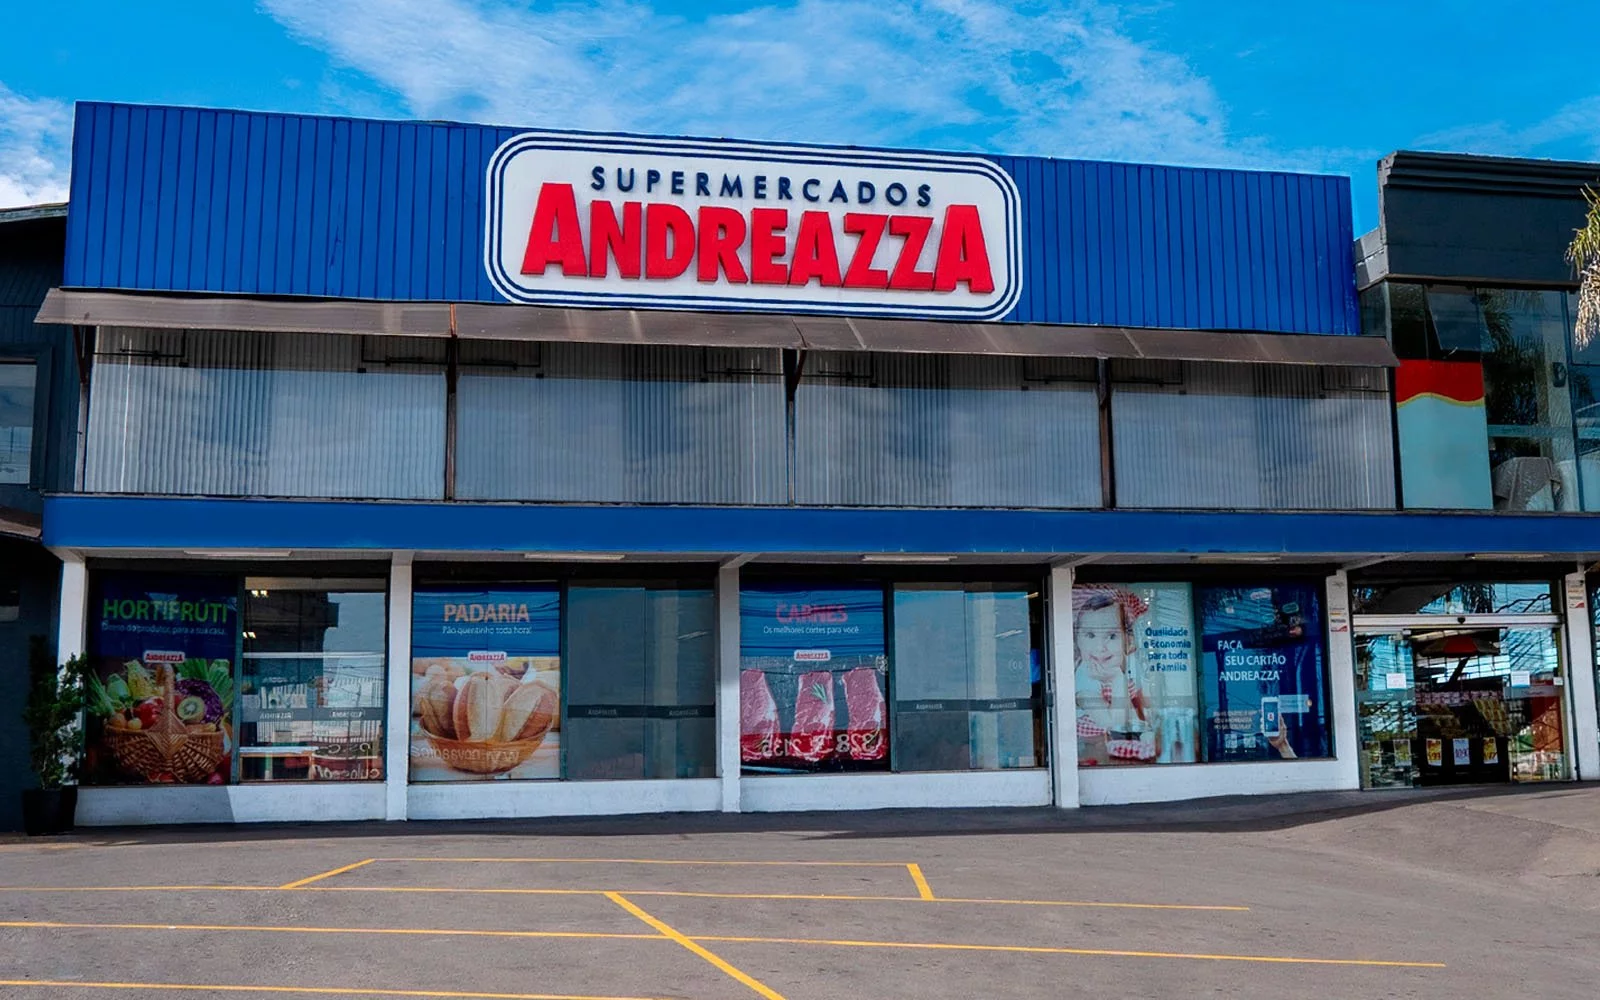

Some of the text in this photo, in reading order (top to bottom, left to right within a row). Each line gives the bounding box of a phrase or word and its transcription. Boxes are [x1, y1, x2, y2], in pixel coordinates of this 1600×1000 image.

[590, 165, 933, 207] SUPERMERCADOS
[521, 181, 995, 295] ANDREAZZA
[443, 603, 530, 623] PADARIA
[775, 602, 849, 624] CARNES
[442, 626, 456, 634] Pão
[456, 626, 495, 636] quentinho
[495, 627, 512, 635] toda
[763, 625, 773, 634] Os
[773, 625, 805, 634] melhores
[827, 628, 841, 636] para
[843, 626, 860, 634] você
[1145, 626, 1188, 637] Qualidade
[1150, 639, 1192, 649] Economia
[1217, 640, 1243, 653] FAÇA
[1147, 650, 1188, 662] para toda
[1225, 652, 1287, 666] SEU CARTÃO
